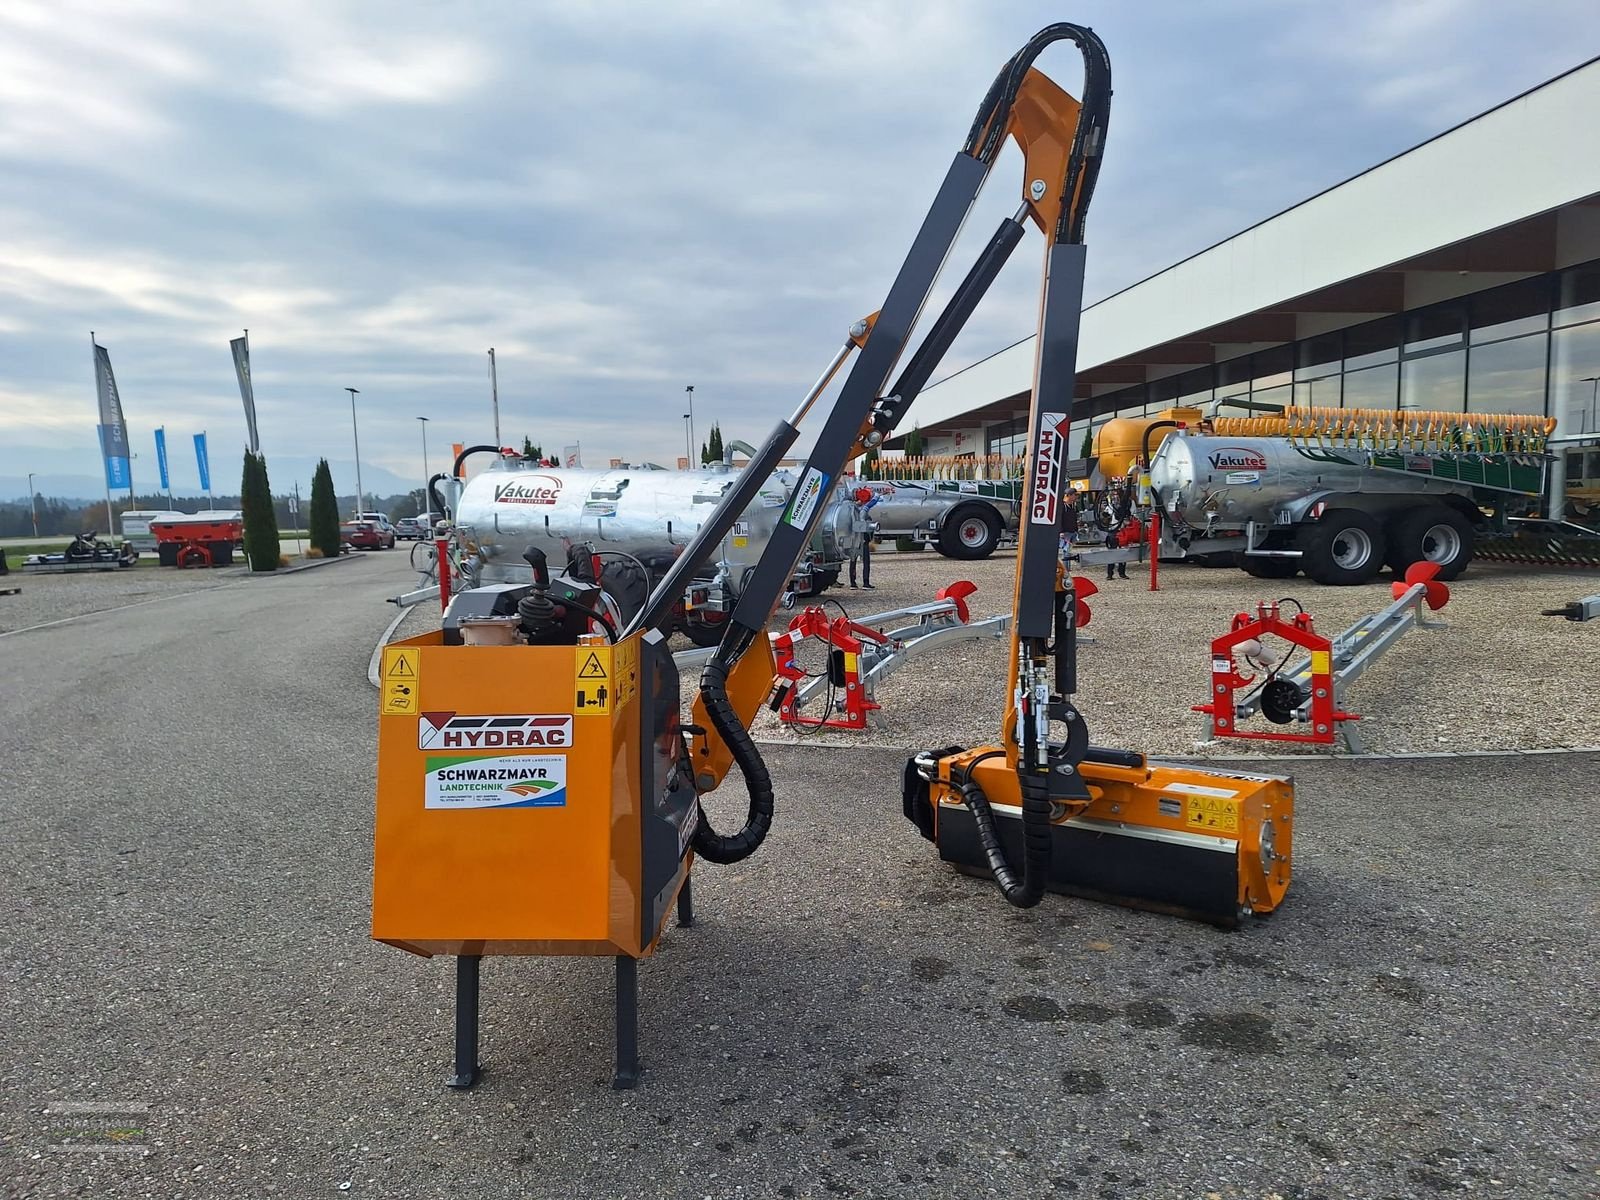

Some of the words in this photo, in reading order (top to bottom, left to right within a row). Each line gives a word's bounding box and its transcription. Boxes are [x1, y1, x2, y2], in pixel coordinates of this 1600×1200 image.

[1208, 453, 1267, 470] Vakutec
[1033, 430, 1054, 519] HYDRAC
[494, 481, 560, 502] Vakutec
[791, 477, 816, 520] SCHWARZMAYR
[443, 729, 566, 747] HYDRAC
[437, 768, 548, 781] SCHWARZMAYR
[439, 783, 503, 791] LANDTECHNIK
